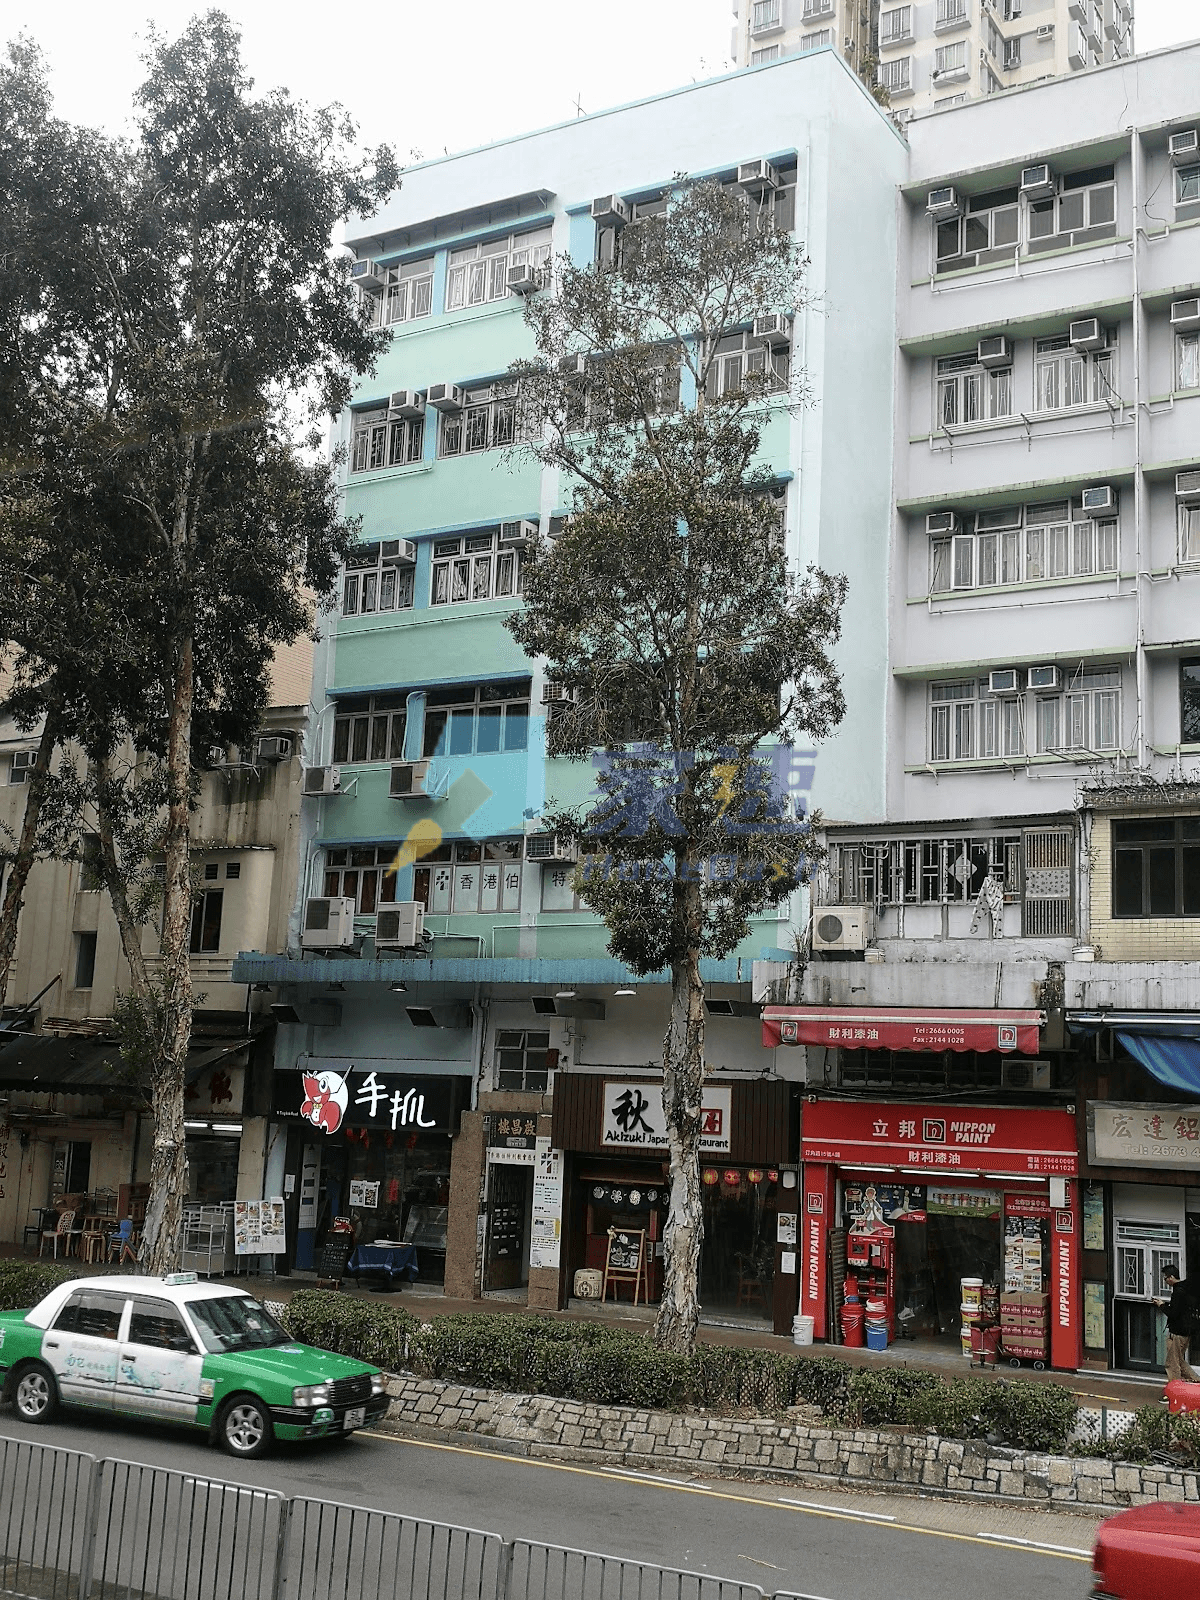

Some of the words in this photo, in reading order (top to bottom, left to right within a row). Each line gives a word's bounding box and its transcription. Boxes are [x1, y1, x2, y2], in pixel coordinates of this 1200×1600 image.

[612, 1088, 655, 1133] 秋
[605, 1130, 646, 1143] Akizuki
[872, 1119, 916, 1138] 立邦
[950, 1121, 996, 1134] NIPPON
[955, 1132, 991, 1144] PAINT
[1151, 1145, 1187, 1157] 2673
[809, 1219, 820, 1253] PAINT
[1060, 1239, 1070, 1277] PAINT
[809, 1254, 819, 1300] NIPPON
[1060, 1278, 1070, 1327] NIPPON
